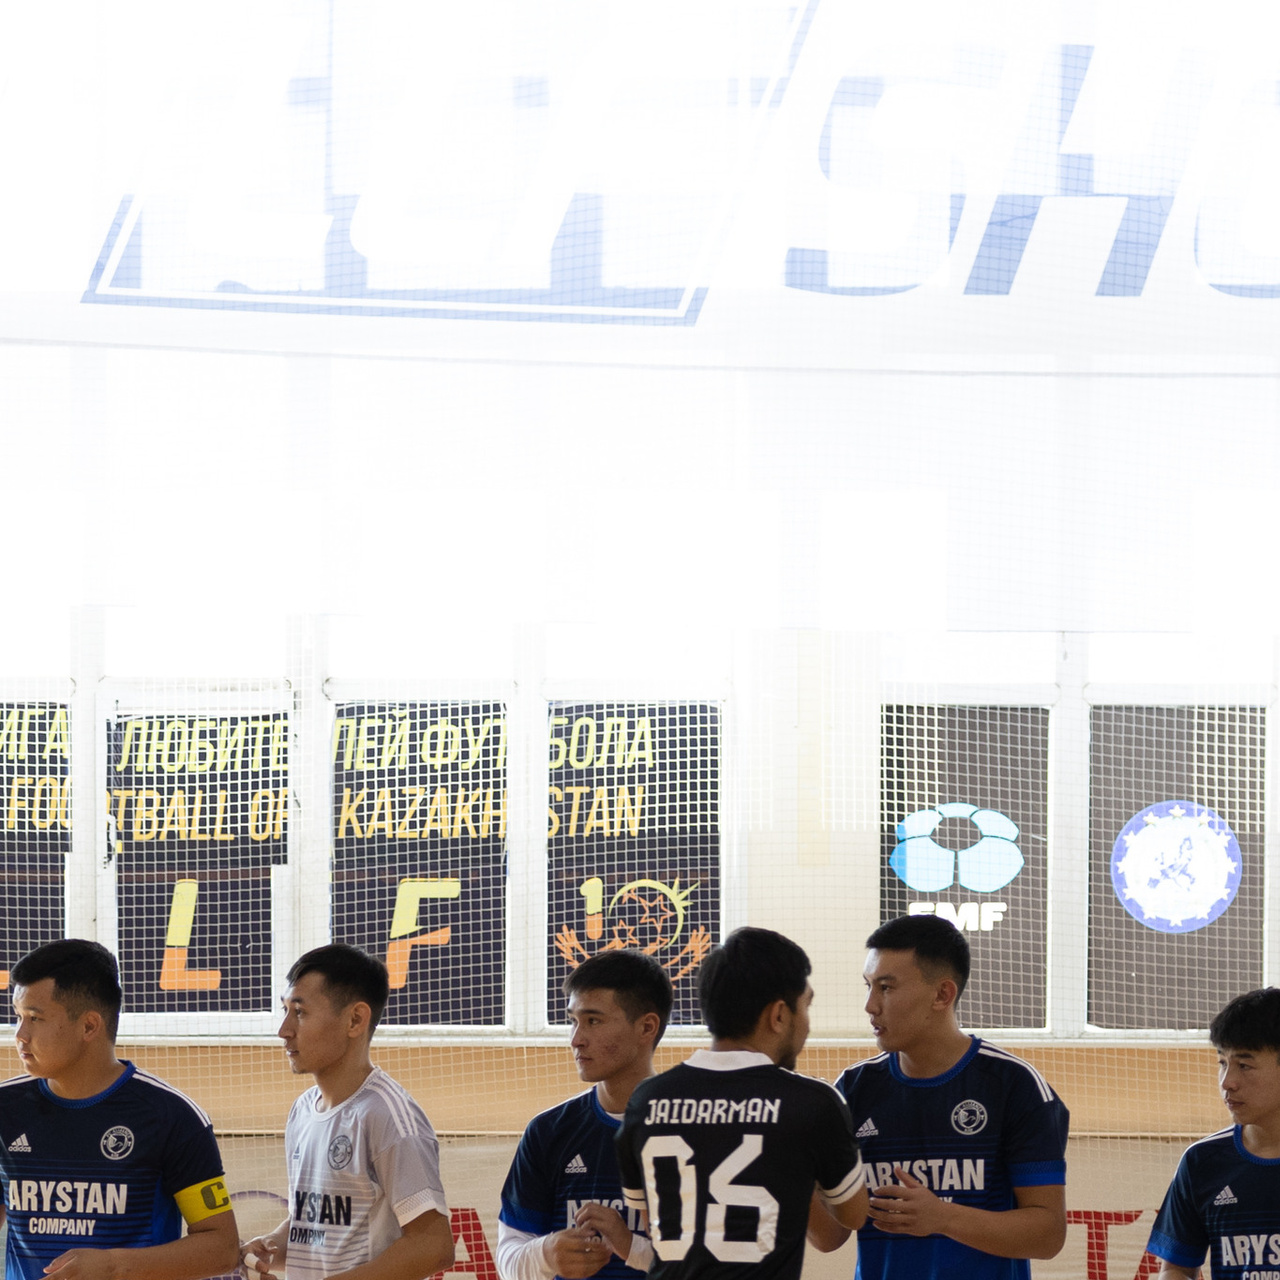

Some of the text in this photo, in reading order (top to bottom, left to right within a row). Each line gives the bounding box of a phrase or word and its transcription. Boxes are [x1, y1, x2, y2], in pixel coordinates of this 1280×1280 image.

[337, 785, 646, 839] KAZAKHSTAN
[159, 878, 222, 992] L
[644, 1097, 781, 1126] JAIDARMAN
[8, 1179, 128, 1215] ARYSTAN
[641, 1133, 780, 1263] 06
[28, 1217, 96, 1237] COMPANY
[1220, 1233, 1280, 1267] ARYS
